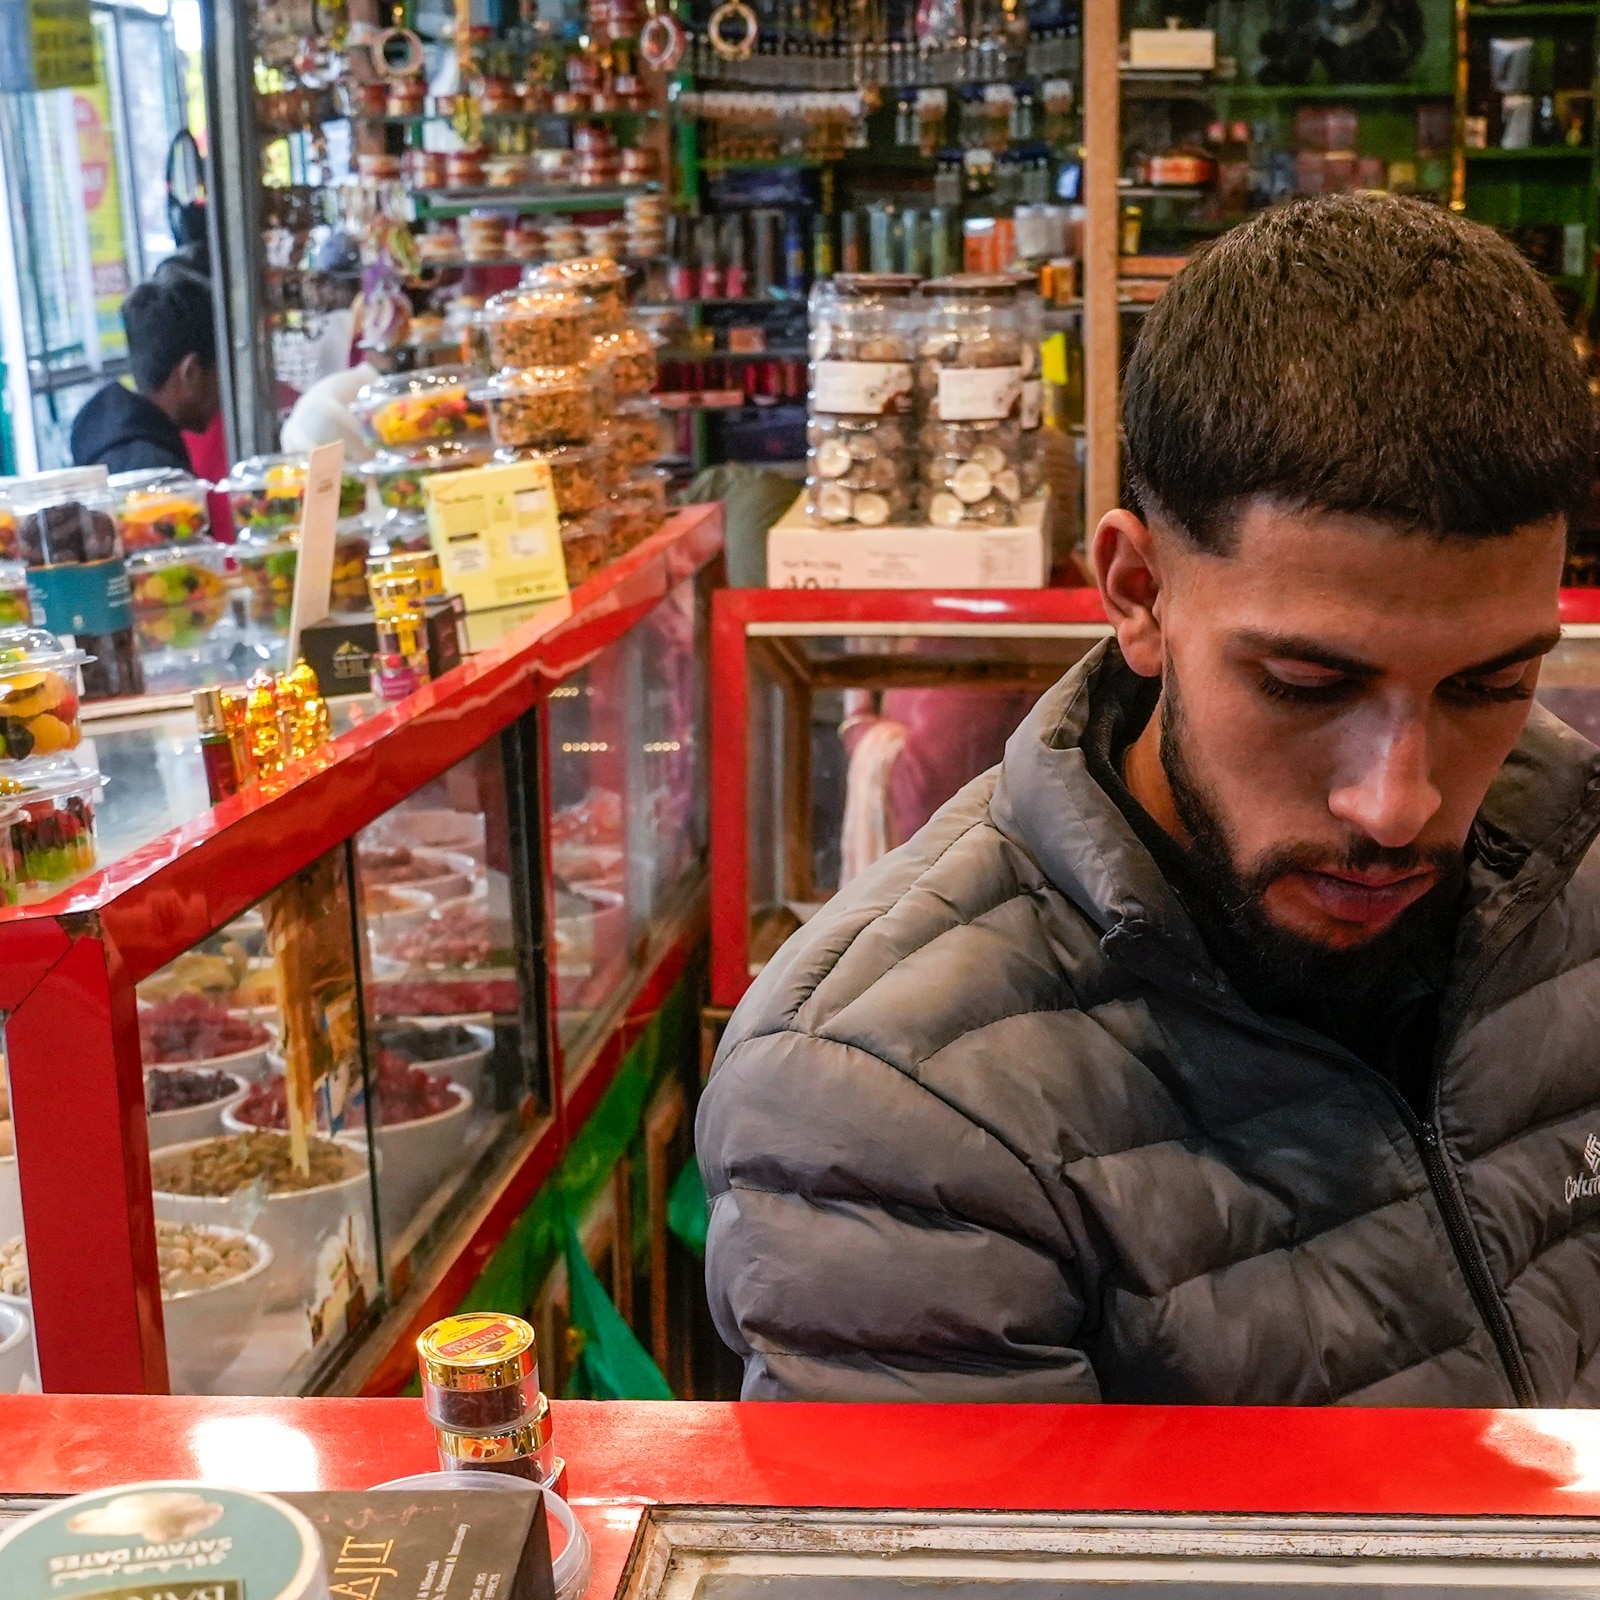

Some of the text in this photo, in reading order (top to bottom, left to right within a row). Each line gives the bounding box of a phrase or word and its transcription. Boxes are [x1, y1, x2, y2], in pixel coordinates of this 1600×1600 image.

[452, 1329, 506, 1354] NATURAL
[50, 1537, 233, 1572] SAFAWI DATES
[419, 1560, 439, 1591] Minerals
